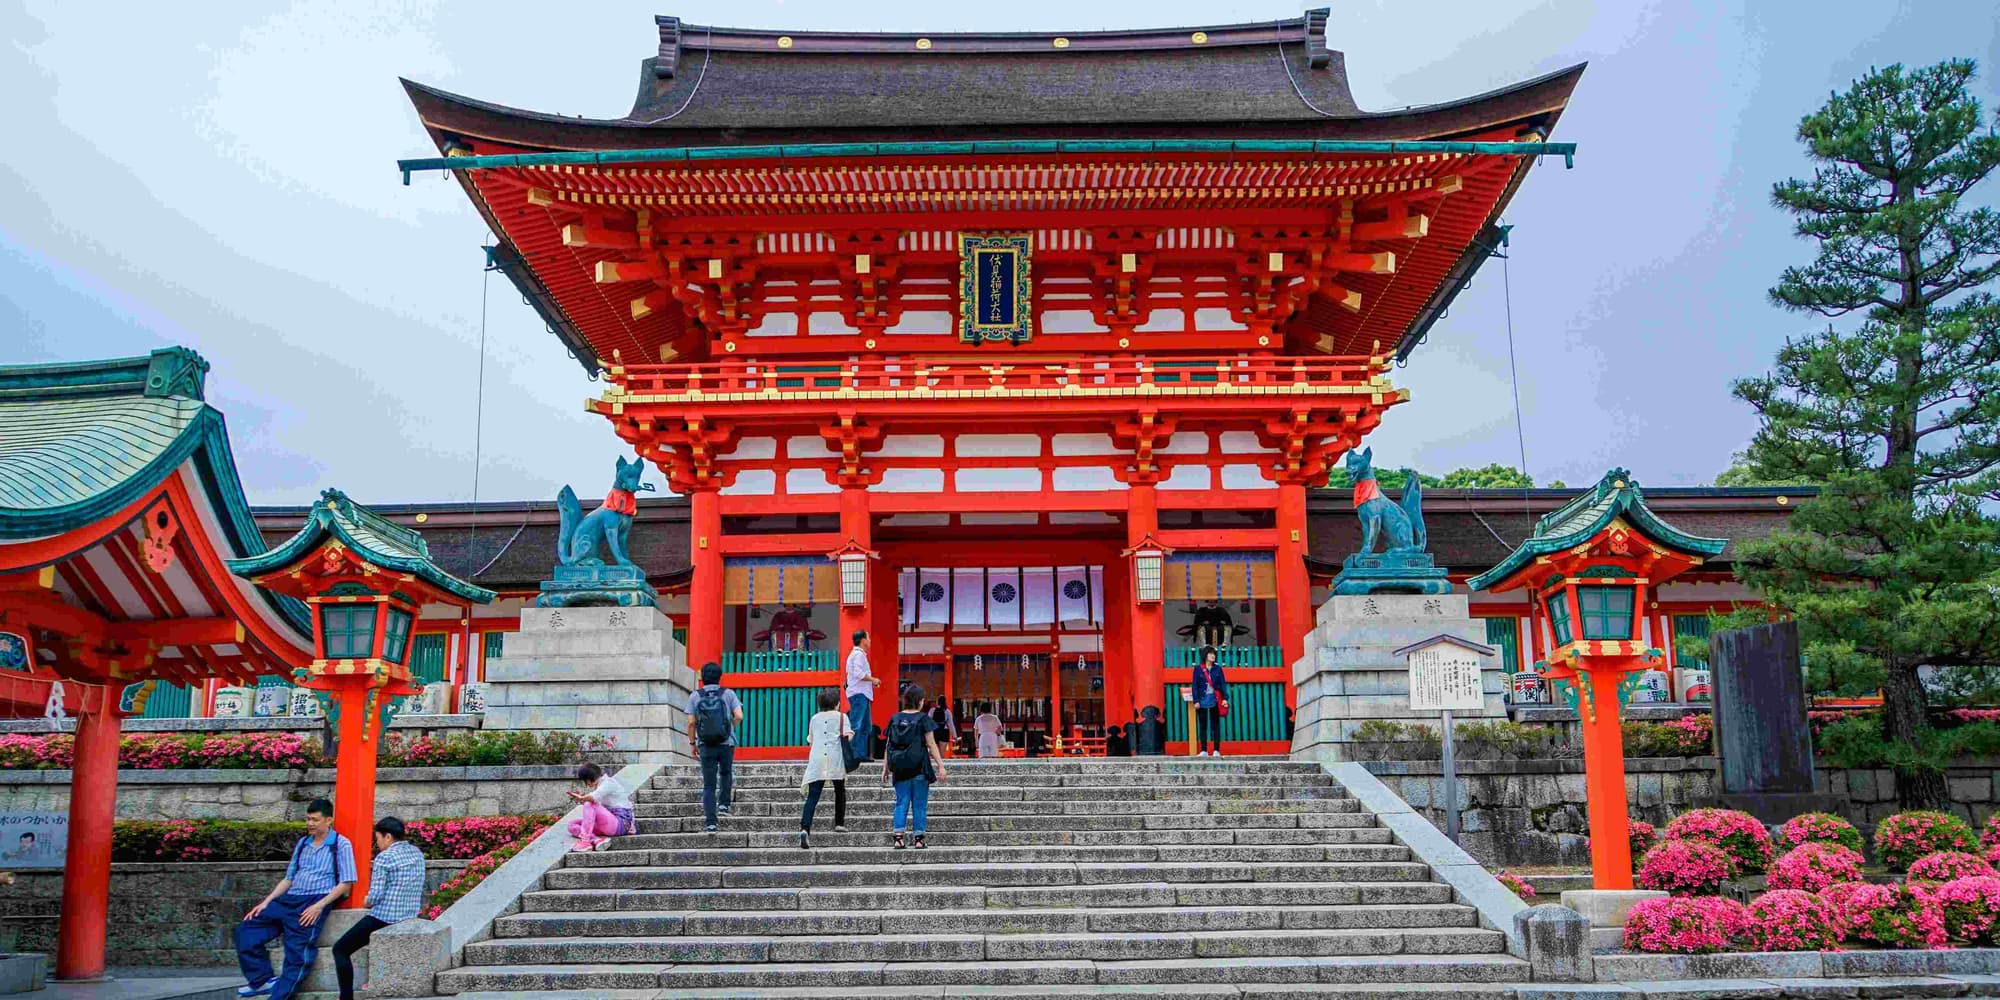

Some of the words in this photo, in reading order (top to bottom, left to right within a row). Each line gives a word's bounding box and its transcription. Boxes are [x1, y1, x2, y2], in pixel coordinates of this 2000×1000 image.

[0, 815, 69, 826] 水のつかいか
